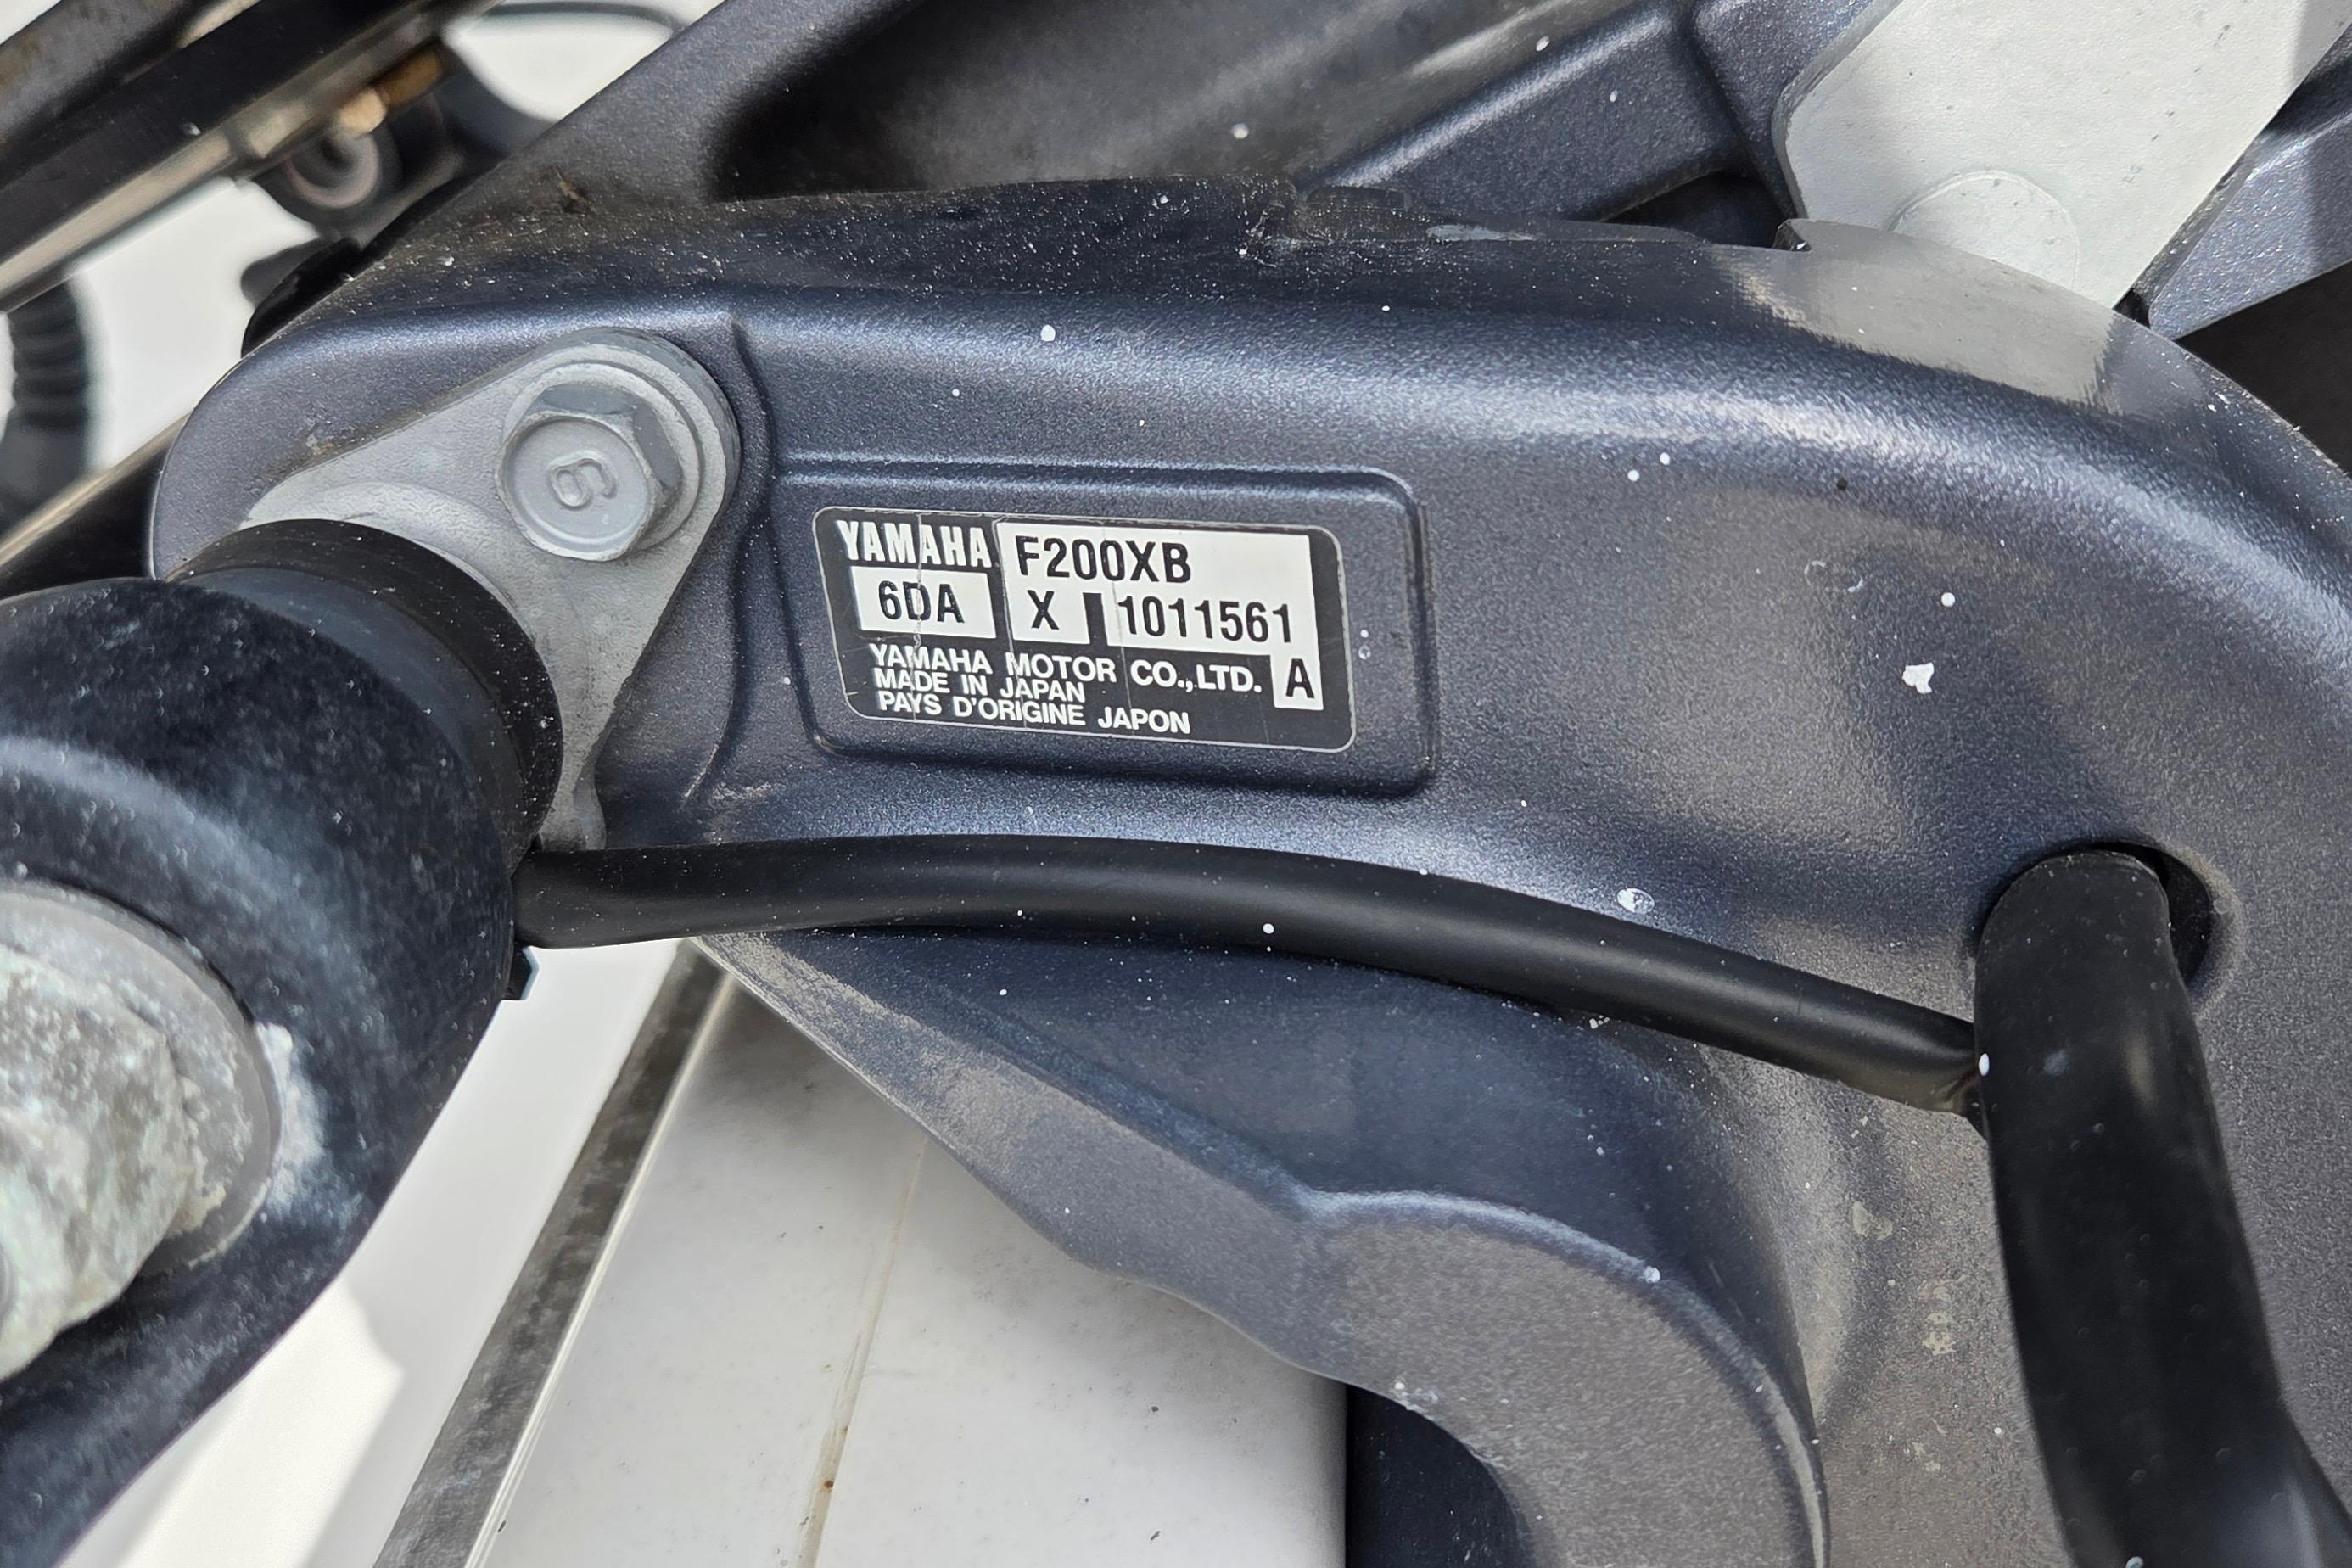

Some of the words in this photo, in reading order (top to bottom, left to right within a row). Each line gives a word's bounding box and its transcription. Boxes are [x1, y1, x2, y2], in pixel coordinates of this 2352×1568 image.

[836, 519, 993, 568] YAMAHA
[1015, 535, 1191, 583] F200XB
[878, 580, 965, 624] 6DA
[1027, 589, 1060, 630] X
[1117, 596, 1291, 643] 1011561
[869, 643, 994, 675] YAMAHA
[1005, 652, 1117, 683] MOTOR
[872, 667, 951, 693] MADE
[960, 674, 988, 696] IN
[1000, 677, 1086, 703] JAPAN
[1285, 658, 1315, 699] A
[877, 690, 943, 715] PAYS
[1097, 706, 1190, 734] JAPON
